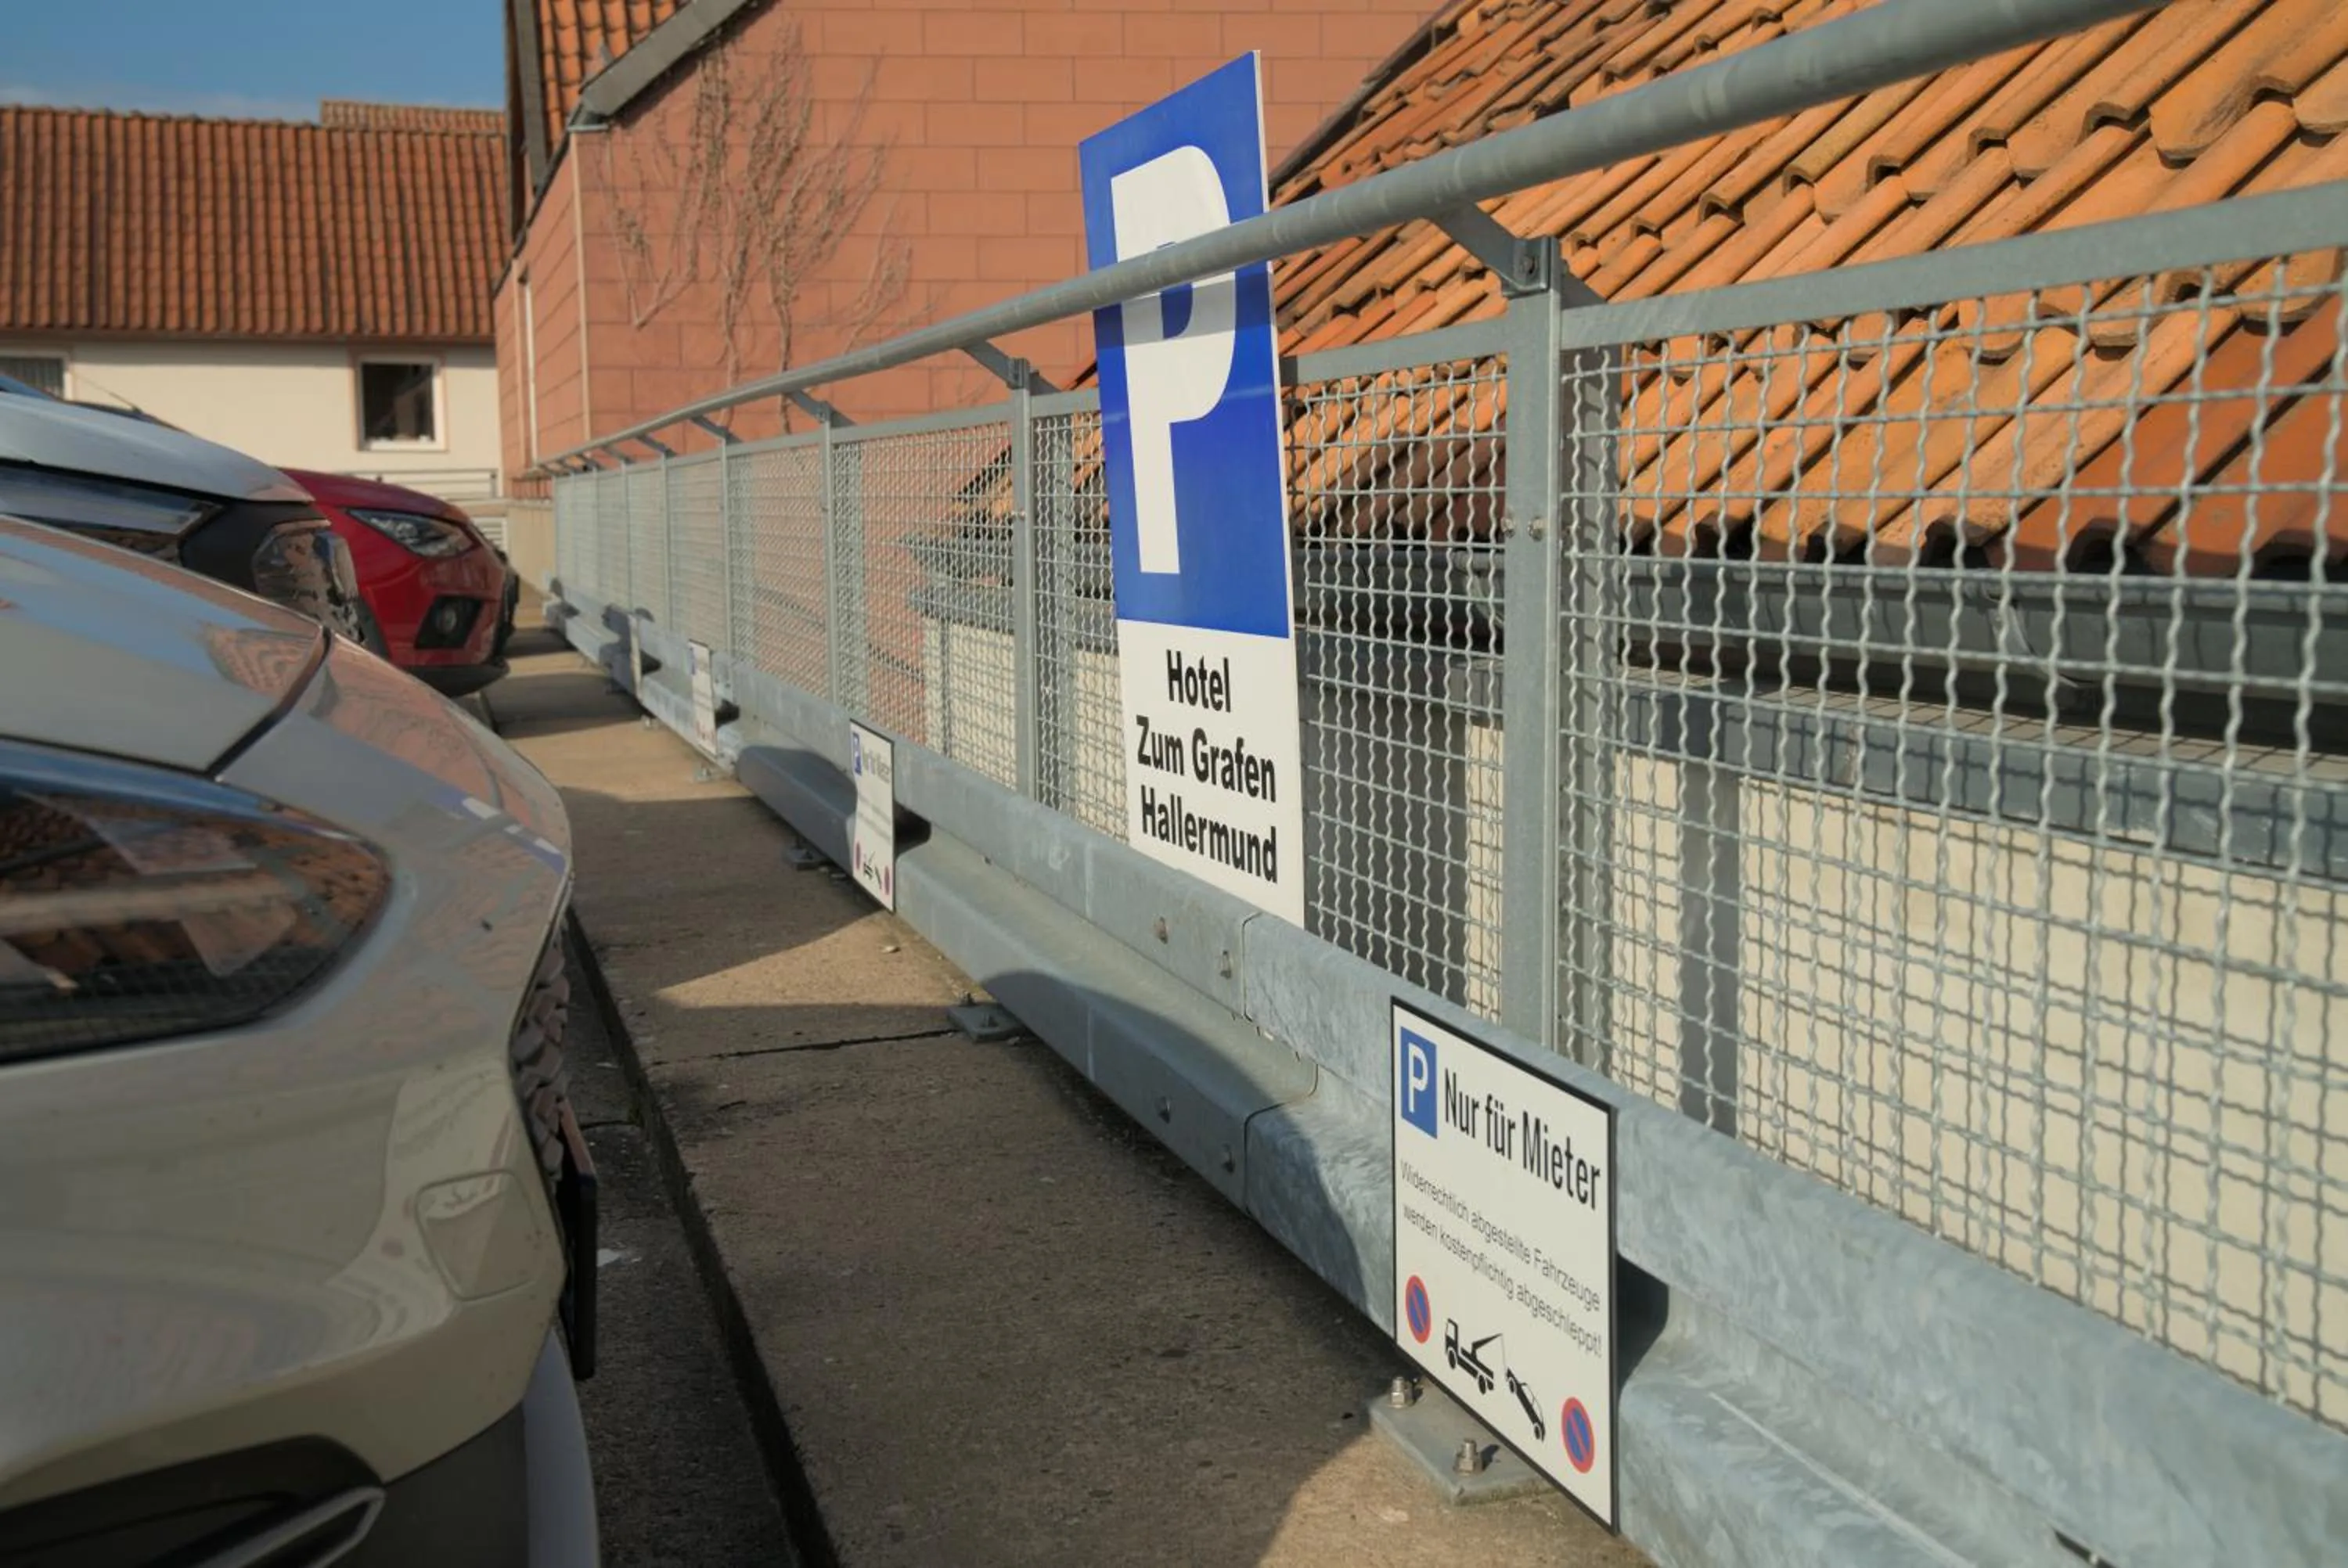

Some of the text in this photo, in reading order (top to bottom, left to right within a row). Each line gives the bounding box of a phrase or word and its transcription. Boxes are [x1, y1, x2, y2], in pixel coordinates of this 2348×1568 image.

[1111, 146, 1236, 574] P
[1167, 649, 1231, 712] Hotel
[1136, 715, 1276, 802] Zum Grafen
[1141, 785, 1278, 883] Hallermund
[1408, 1041, 1428, 1113] P
[1446, 1068, 1601, 1210] Nur für Mieter
[1400, 1160, 1601, 1312] Widerrechtlich abgestellte Fahrzeuge
[1403, 1203, 1601, 1358] werden kostenpflichtig abgeschleppt!
